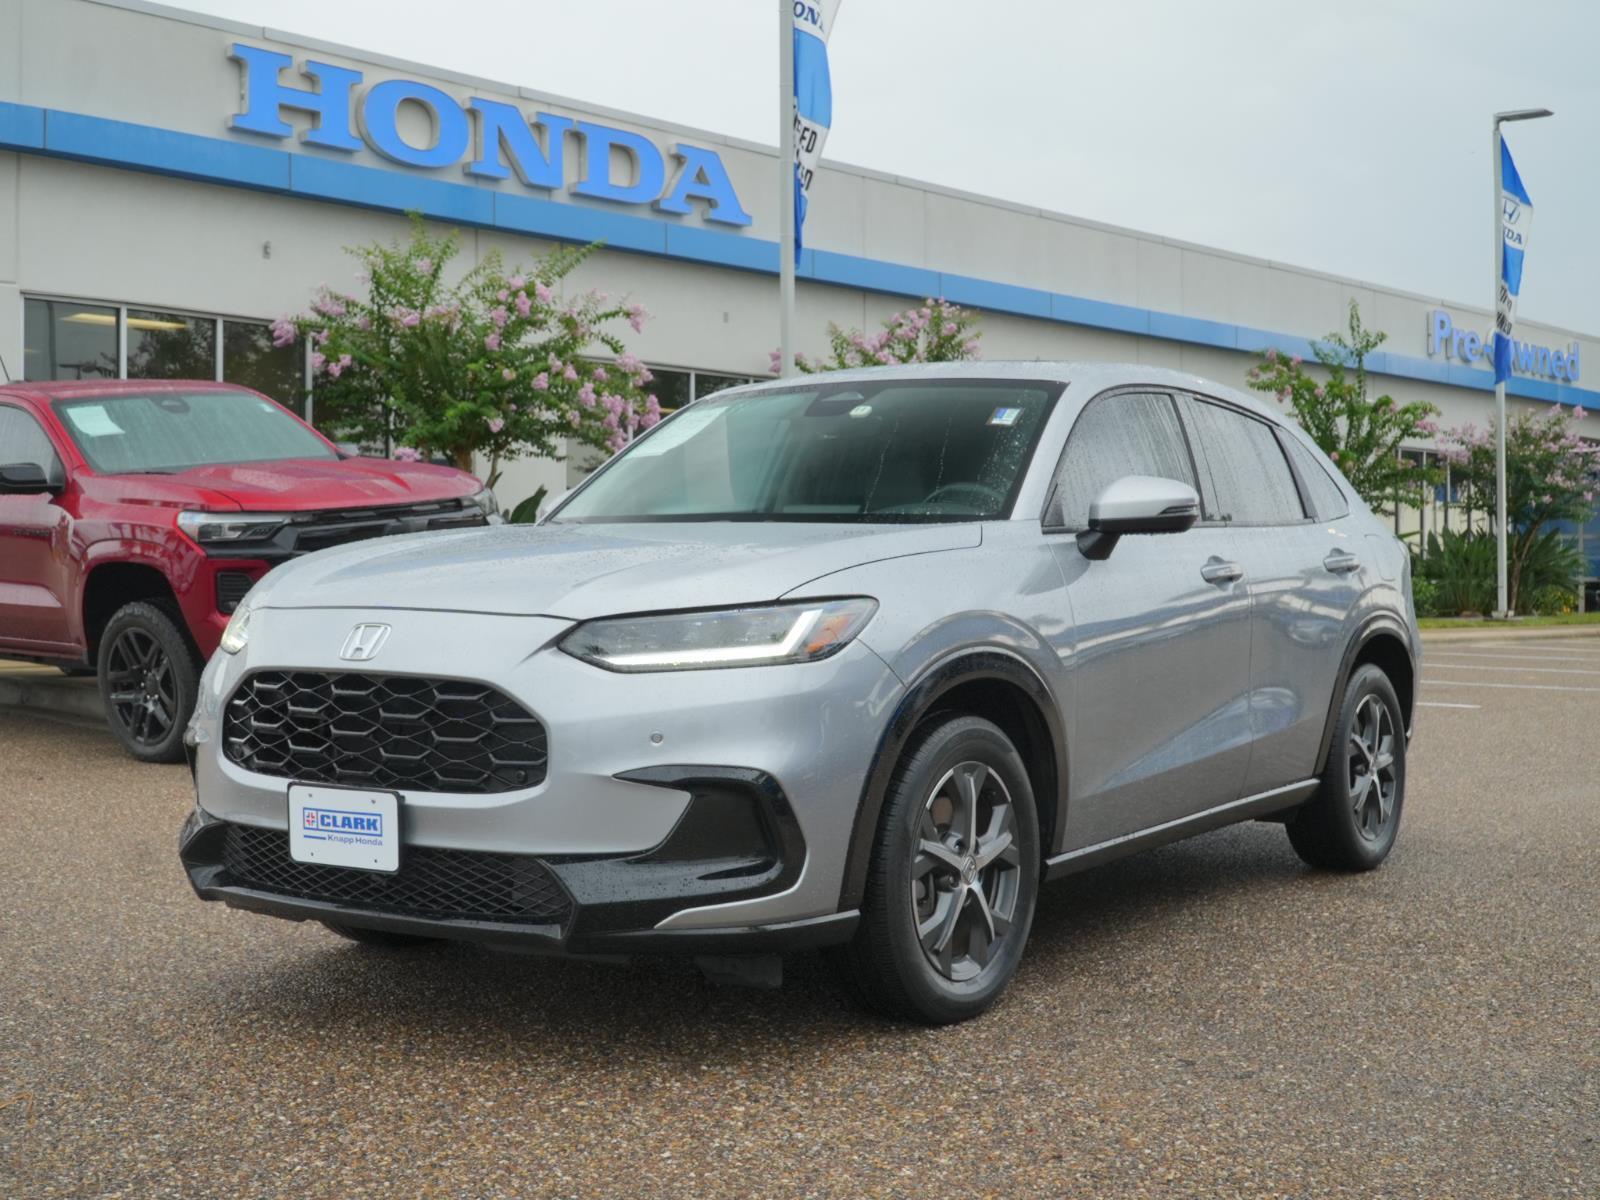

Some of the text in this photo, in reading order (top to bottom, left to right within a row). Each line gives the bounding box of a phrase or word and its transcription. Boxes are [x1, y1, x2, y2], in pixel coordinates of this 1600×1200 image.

[227, 43, 753, 227] HONDA
[1430, 310, 1580, 383] Pre-wned
[320, 814, 378, 831] CLARK
[327, 834, 383, 847] Knapp Honda
